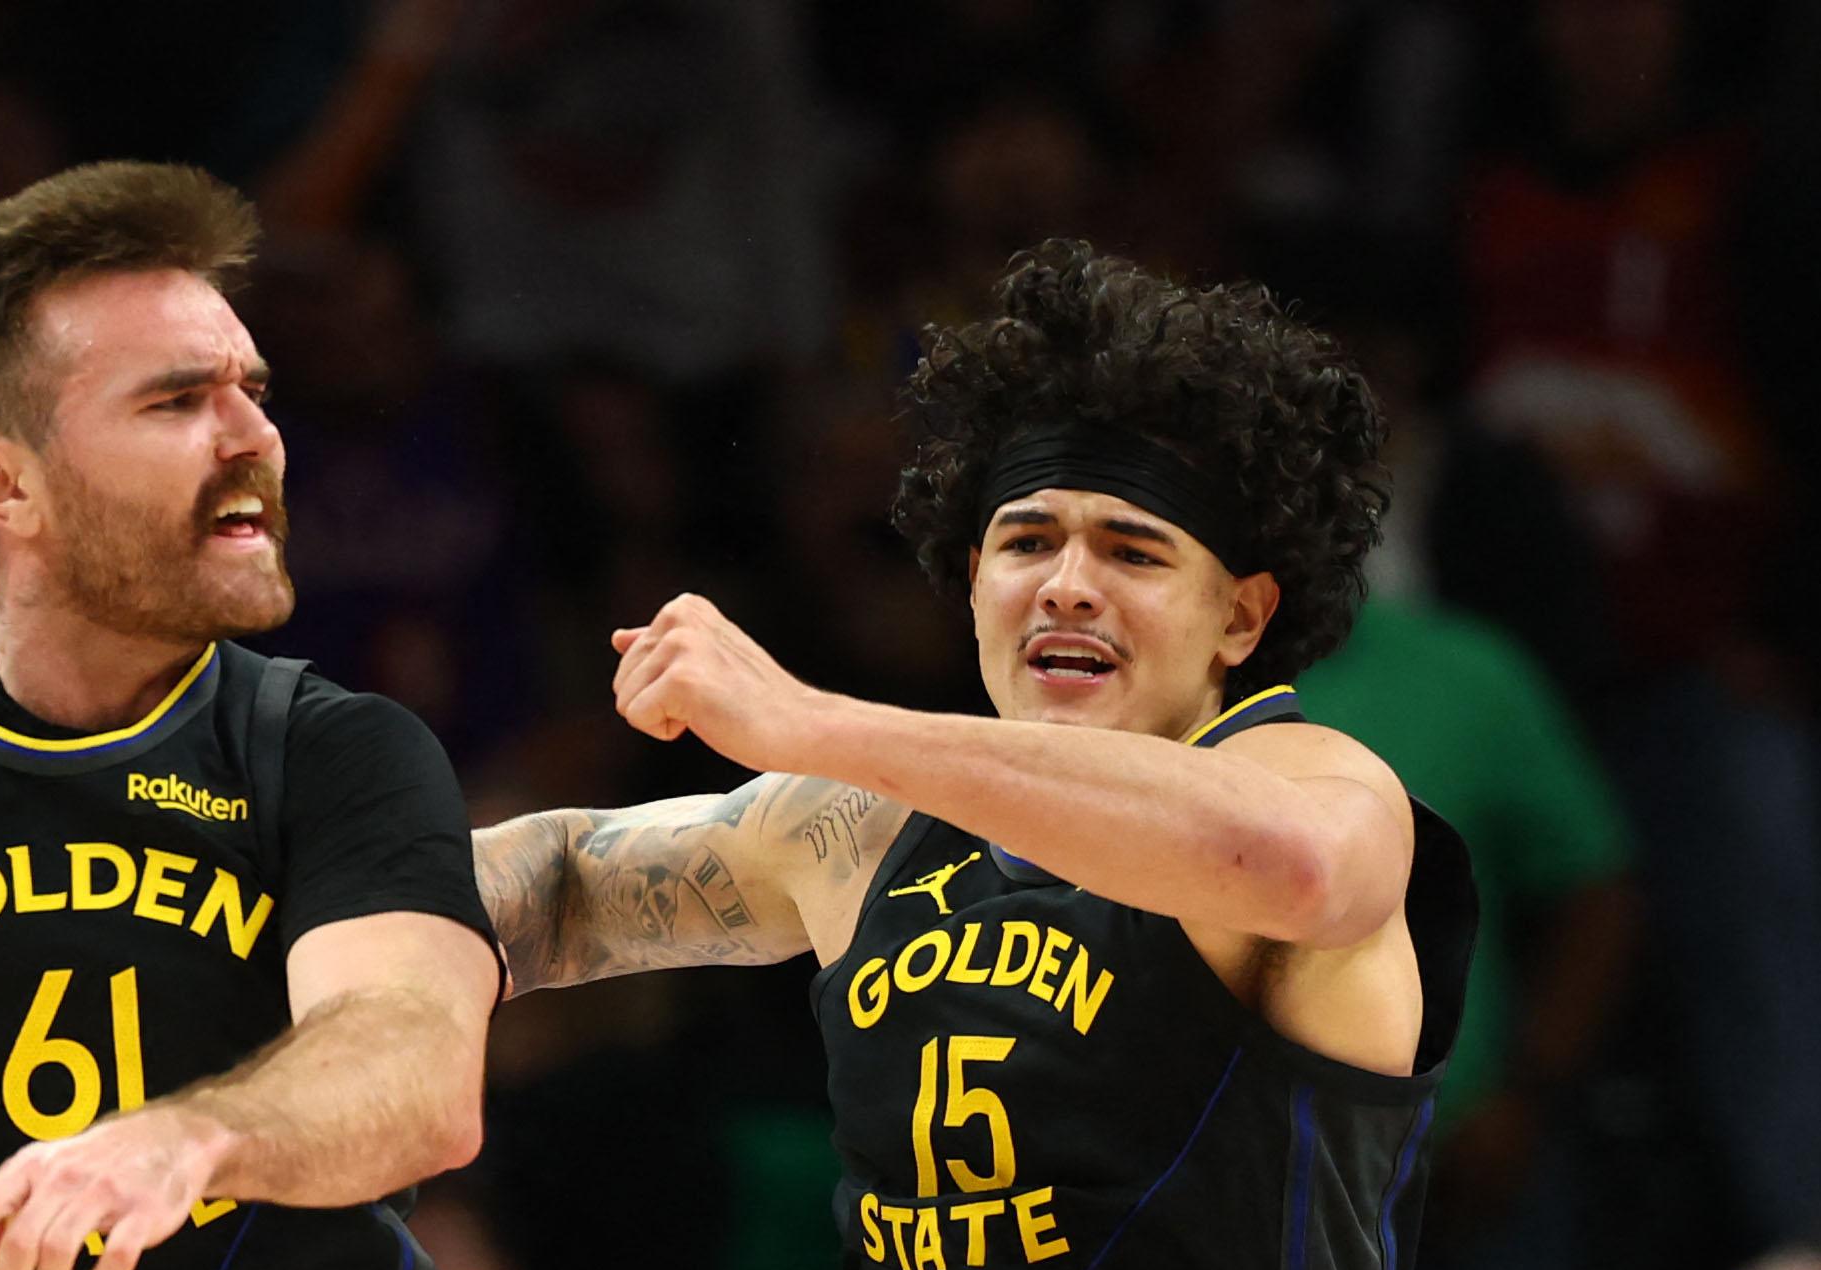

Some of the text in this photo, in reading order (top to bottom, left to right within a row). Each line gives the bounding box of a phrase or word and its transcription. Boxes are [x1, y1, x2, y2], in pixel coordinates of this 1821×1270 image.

[127, 773, 248, 821] Rakuten
[847, 920, 1115, 1036] GOLDEN
[2, 966, 146, 1142] 61
[912, 1035, 1017, 1198] 15
